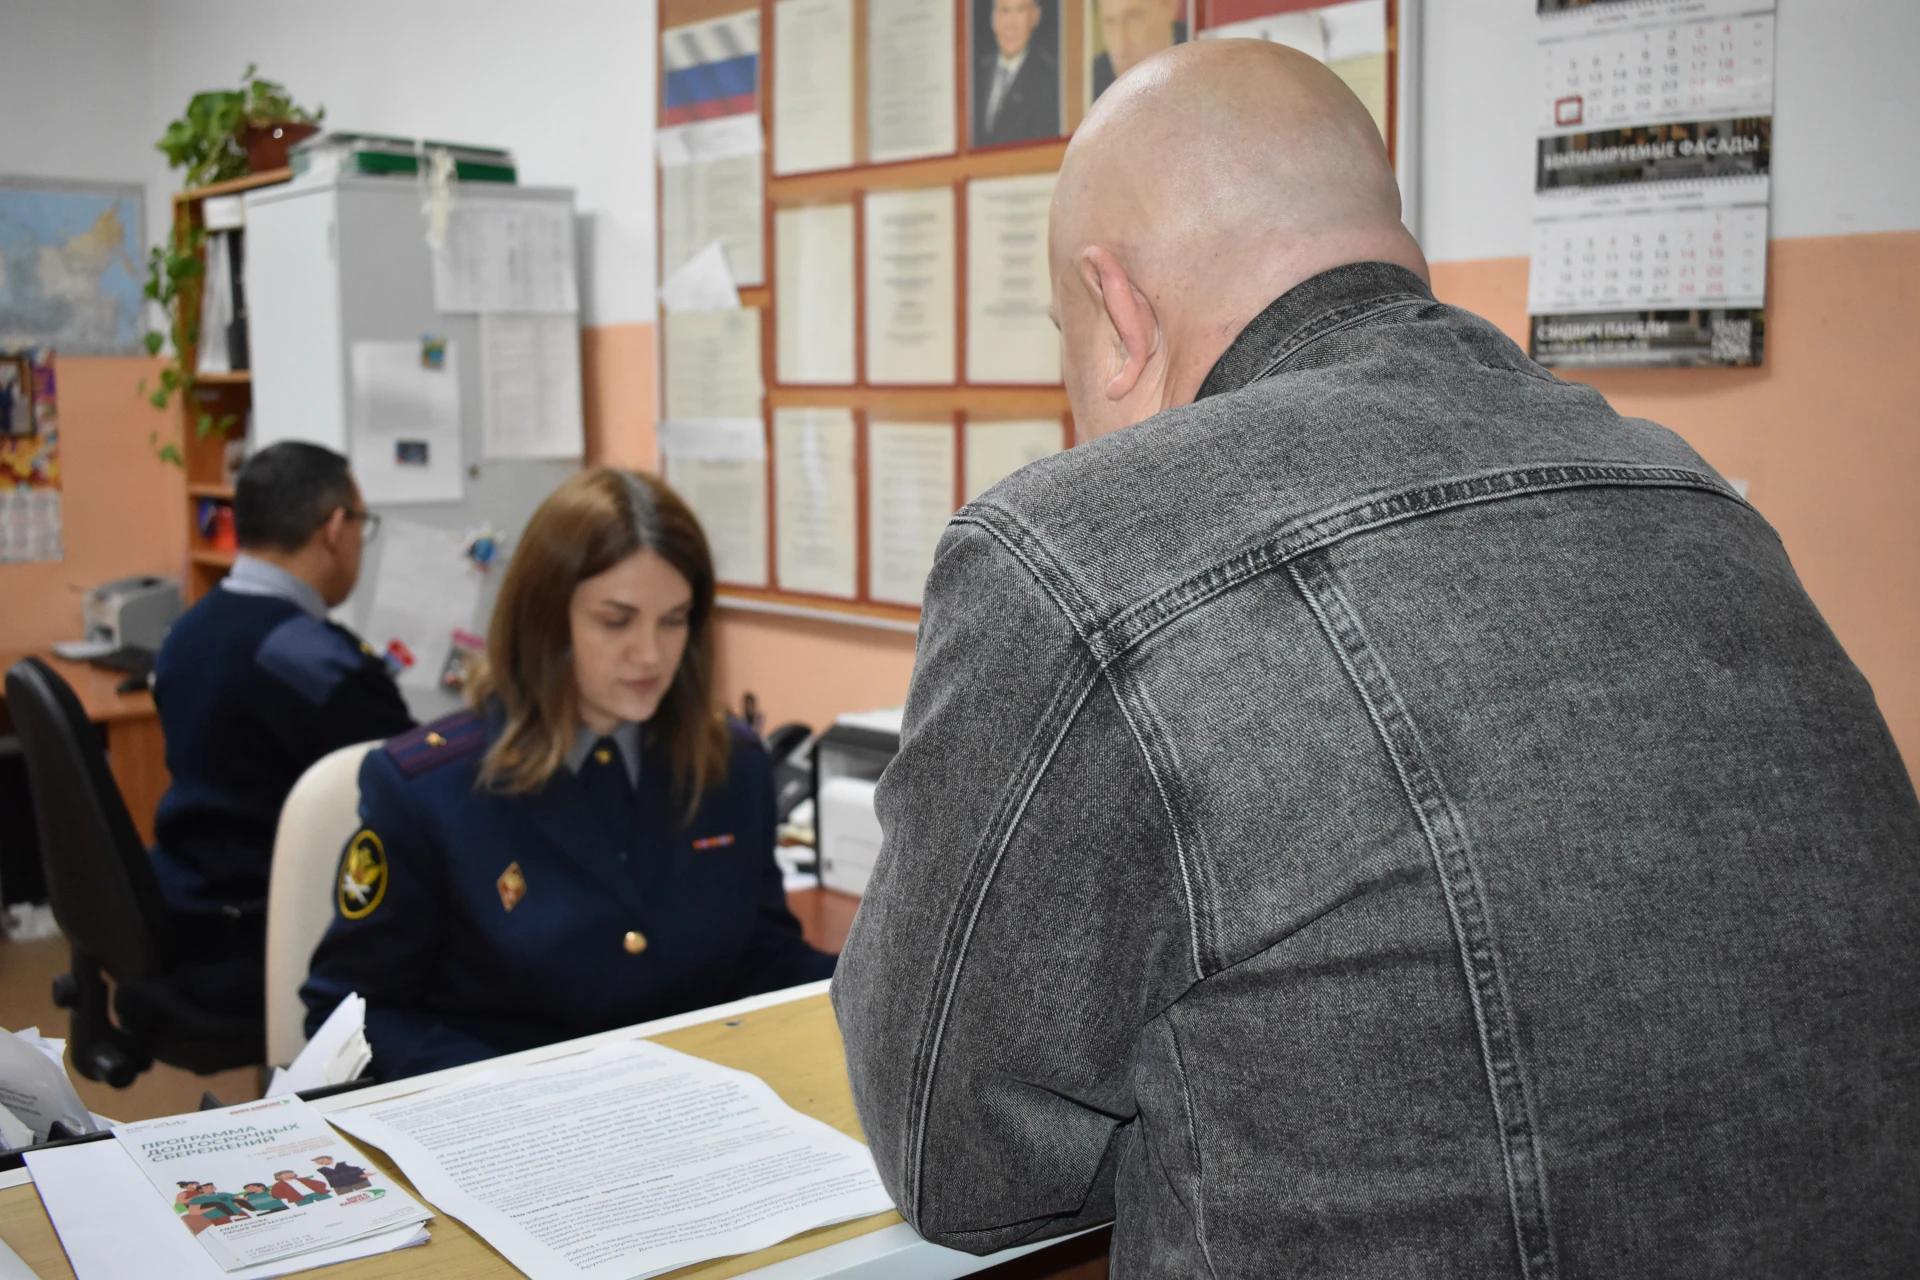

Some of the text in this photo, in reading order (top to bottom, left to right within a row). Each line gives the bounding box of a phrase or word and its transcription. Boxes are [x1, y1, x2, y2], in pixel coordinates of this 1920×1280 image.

[1678, 135, 1759, 157] ФАСАДЫ
[142, 1125, 257, 1150] ПРОГРАММА
[147, 1122, 300, 1158] ДОЛГОСРОЧНЫХ
[151, 1135, 276, 1163] СБЕРЕЖЕНИЙ
